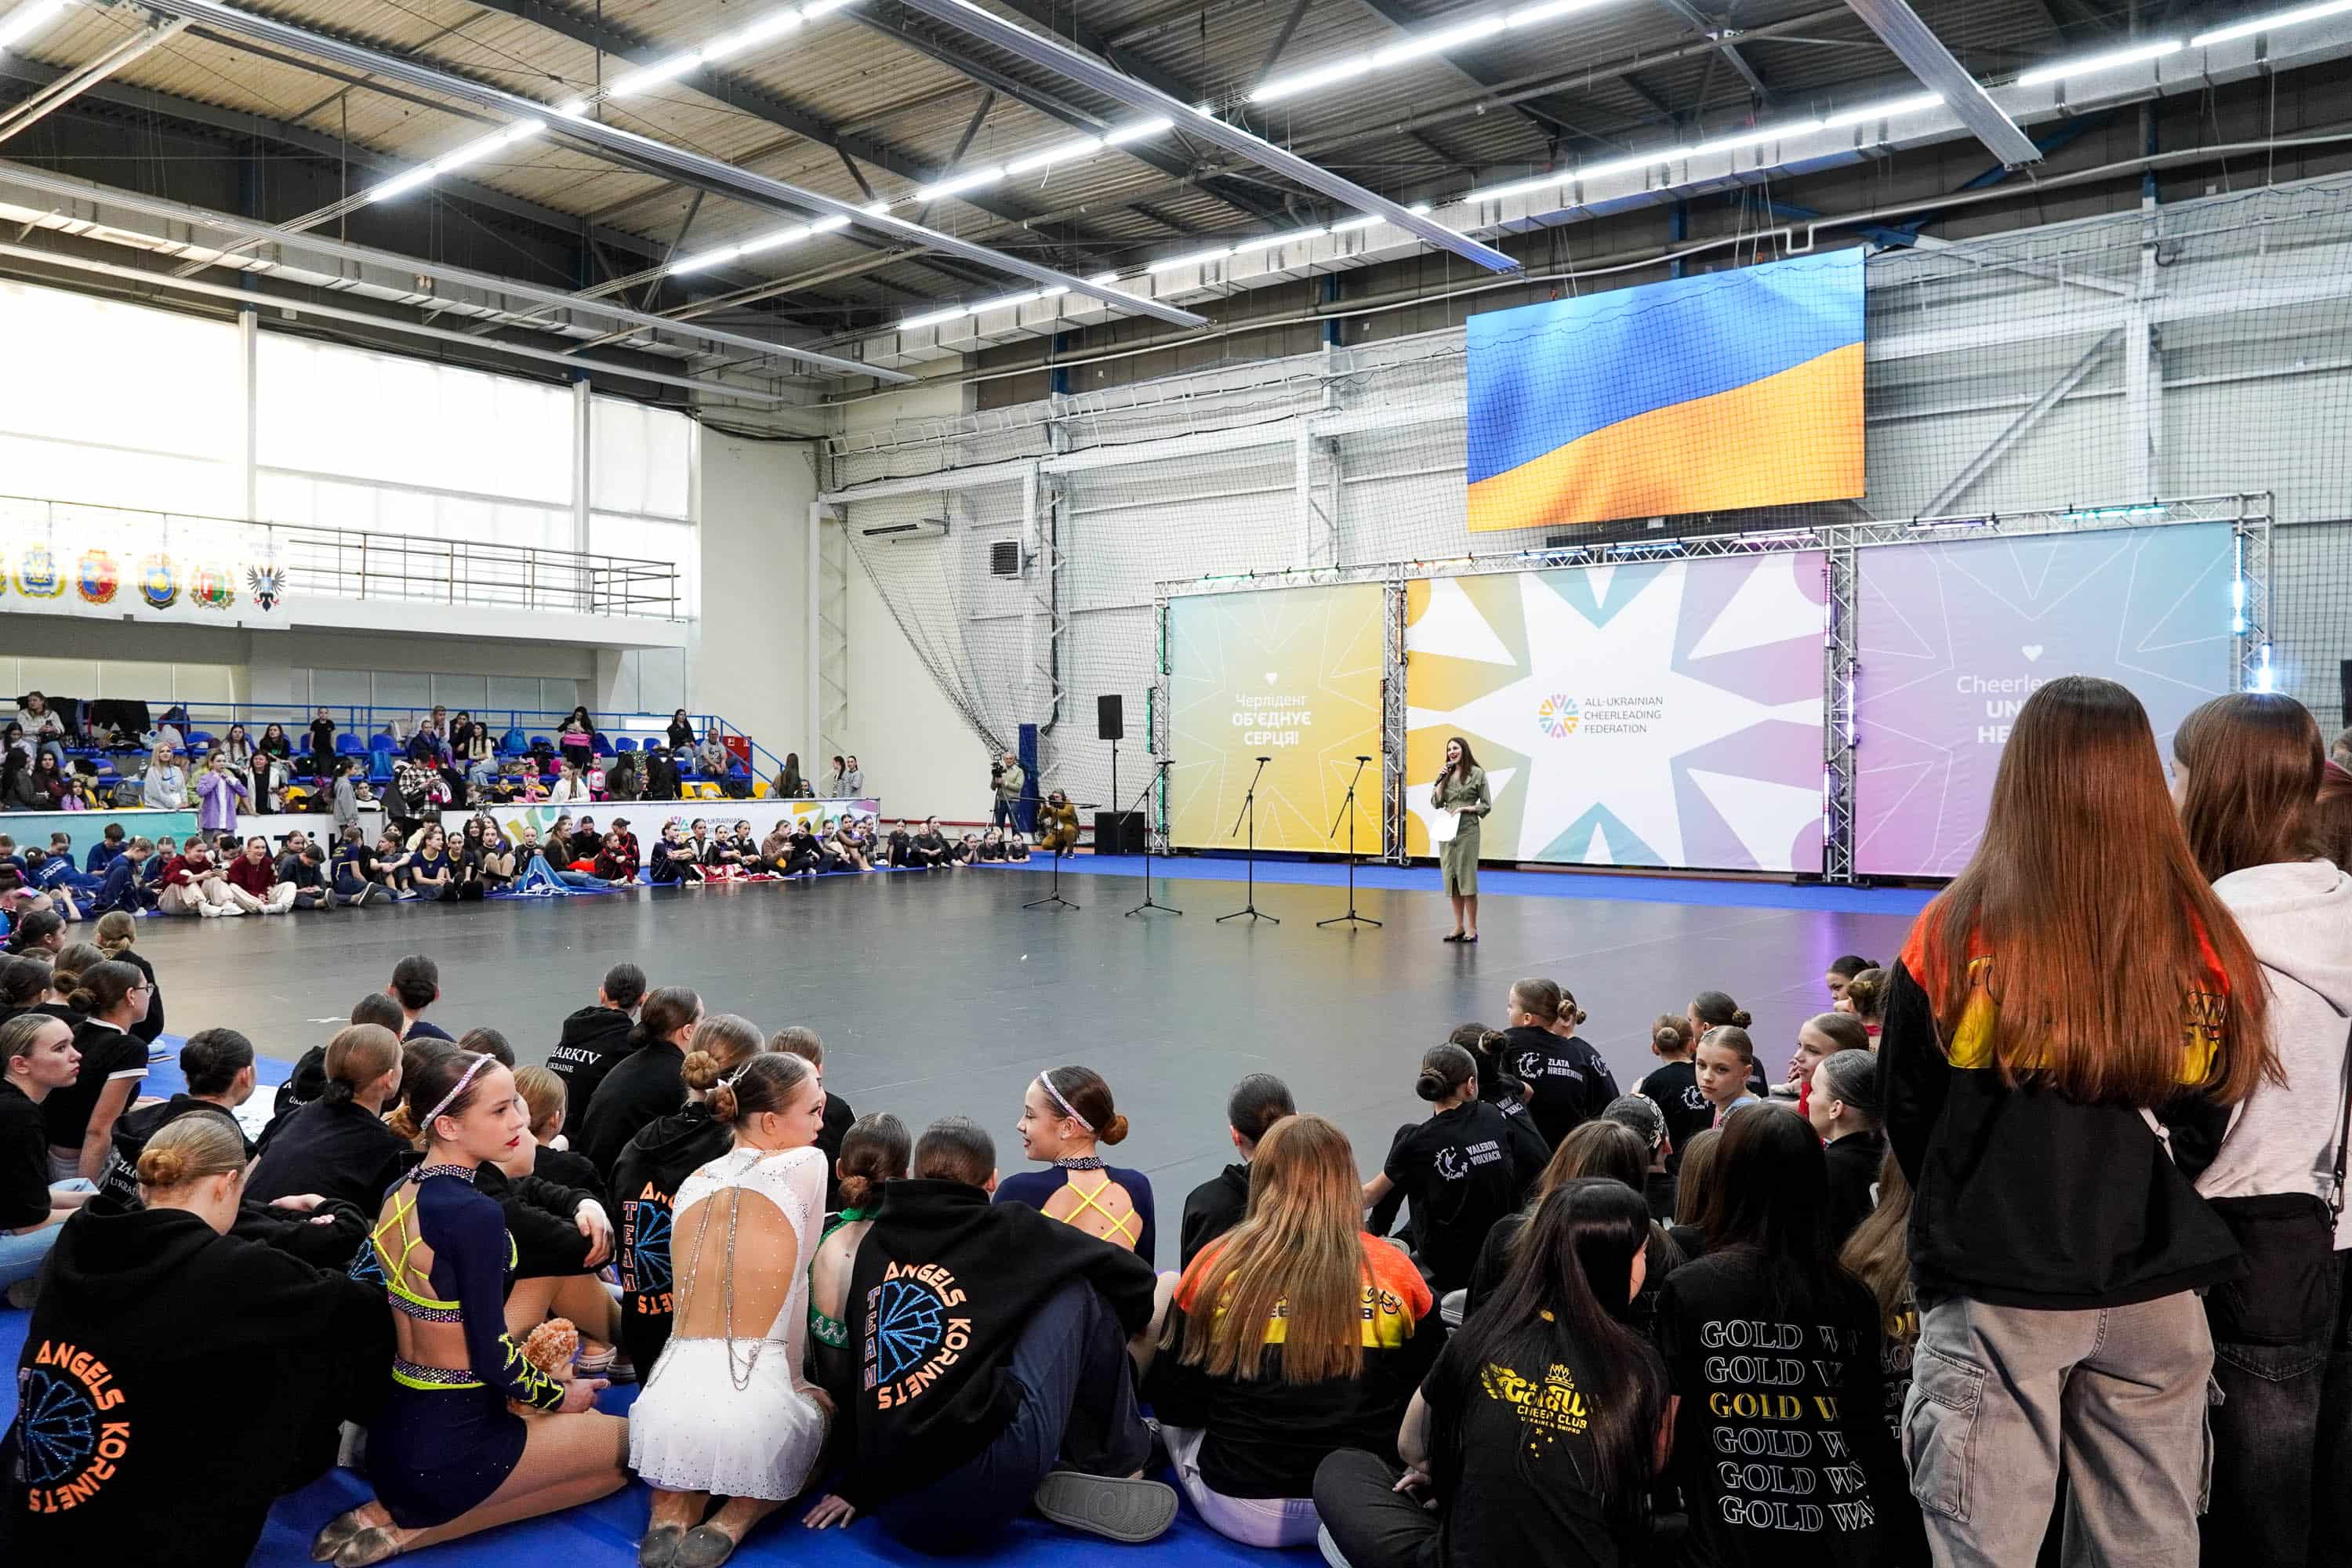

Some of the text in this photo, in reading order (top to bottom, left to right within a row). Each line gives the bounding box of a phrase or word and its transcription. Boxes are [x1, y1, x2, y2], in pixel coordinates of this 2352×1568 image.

[1957, 673, 2070, 694] Cheerle
[1236, 692, 1308, 710] Черліденг
[1584, 696, 1664, 707] ALL-UKRAINIAN
[1584, 710, 1662, 720] CHEERLEADING
[1986, 700, 2025, 718] UN
[1584, 724, 1648, 735] FEDERATION
[1977, 725, 2013, 743] HE
[551, 1046, 602, 1065] ARKIV
[1548, 1058, 1570, 1068] ZLATA
[1470, 1150, 1501, 1166] VOLVACH
[622, 1201, 637, 1292] TEAM
[884, 1261, 967, 1307] ANGELS
[865, 1286, 881, 1392] TEAM
[1700, 1319, 1803, 1349] GOLD
[35, 1339, 126, 1410] ANGELS
[878, 1318, 971, 1410] KORINETS
[1705, 1356, 1805, 1385] GOLD
[1710, 1392, 1802, 1421] GOLD
[1557, 1414, 1588, 1429] CLUB
[1713, 1427, 1813, 1457] GOLD
[29, 1421, 130, 1514] KORINETS
[1718, 1461, 1817, 1495] GOLD
[1719, 1495, 1824, 1532] GOLD
